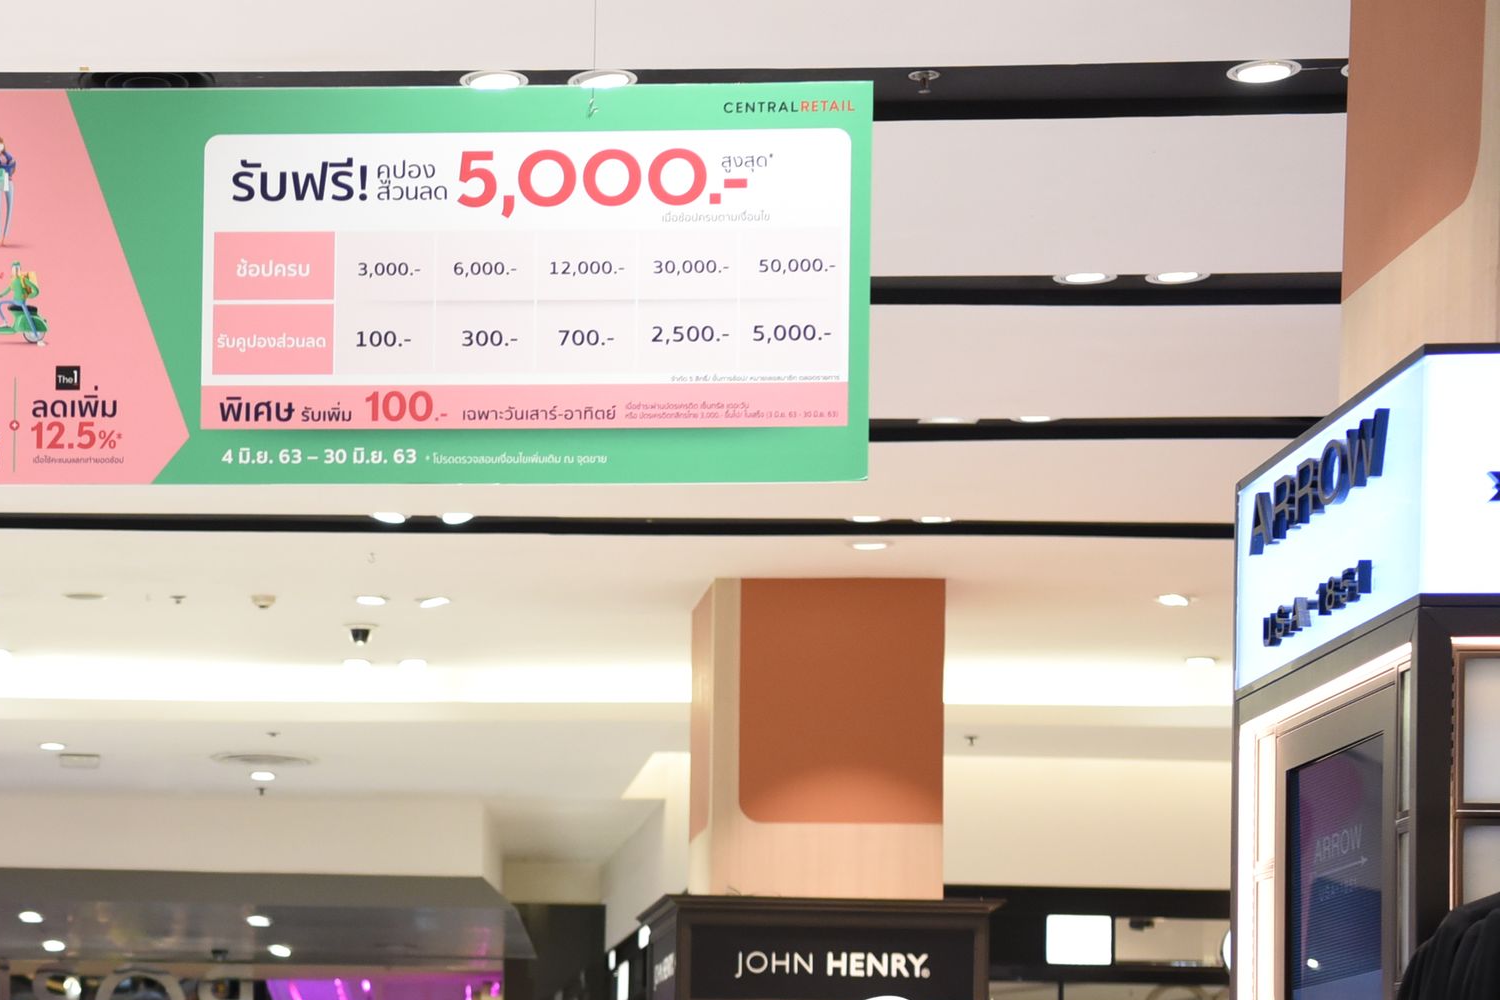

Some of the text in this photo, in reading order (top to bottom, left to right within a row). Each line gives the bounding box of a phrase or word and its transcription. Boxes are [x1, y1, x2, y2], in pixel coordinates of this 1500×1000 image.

[232, 157, 368, 202] รับฟรี!
[377, 160, 436, 184] คูปอง
[457, 148, 748, 218] 5,000.-
[377, 181, 448, 201] ส่วนลด
[236, 258, 310, 277] ช้อปครบ
[357, 258, 836, 279] 3,000.- 6,000.- 12,000.- 30,000.- 50,000.-
[217, 333, 327, 353] รับคูปองส่วนลด
[356, 324, 832, 348] 100.- 300.- 700.- 2,500.- 5,000.-
[32, 385, 117, 418] ลดเพิ่ม
[219, 390, 617, 422] พิเศษ รับเพิ่ม 100.- เฉพาะวันเสาร์-อาทิตย์
[221, 450, 233, 464] 4
[238, 448, 274, 464] มิ.ย.
[279, 450, 302, 464] 63
[324, 449, 347, 464] 30
[353, 447, 388, 464] มิ.ย.
[394, 449, 417, 464] 63
[577, 454, 609, 467] จุดขาย
[1249, 408, 1390, 556] ARROW
[1315, 823, 1362, 863] ARROW
[734, 951, 814, 979] JOHN
